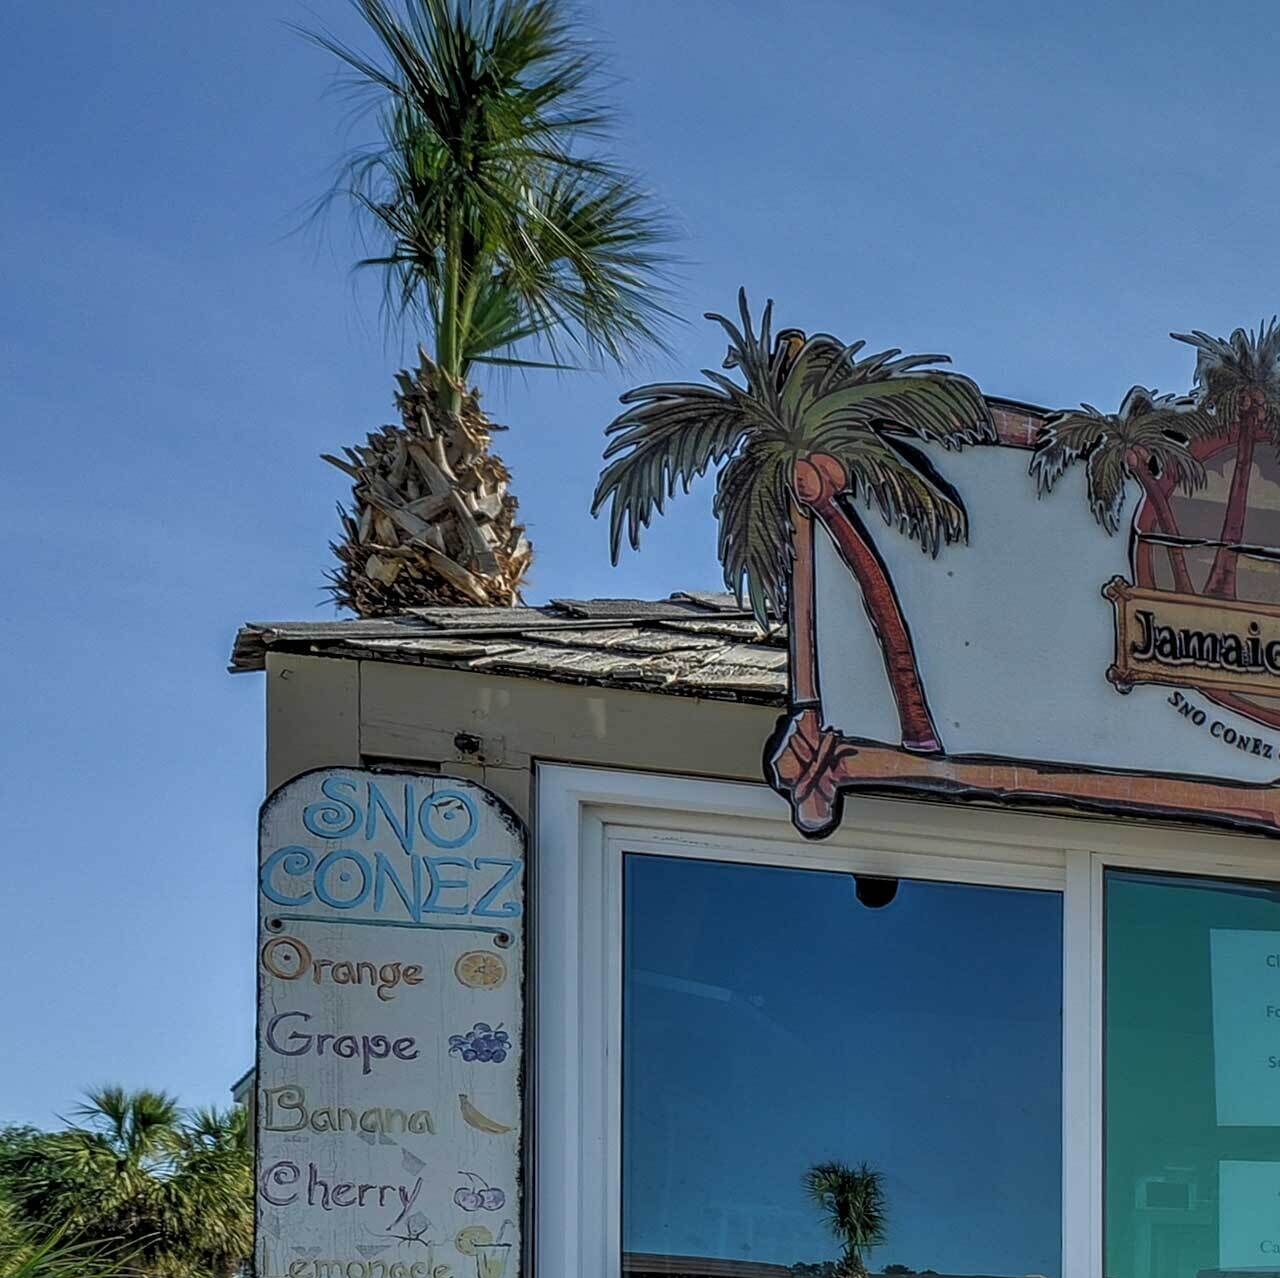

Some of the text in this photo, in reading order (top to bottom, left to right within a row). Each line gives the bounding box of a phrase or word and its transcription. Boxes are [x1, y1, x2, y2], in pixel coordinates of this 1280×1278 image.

[1167, 690, 1207, 727] SNO
[1209, 720, 1273, 760] CONEZ
[303, 777, 479, 850] SNO
[260, 845, 521, 922] CONEZ
[261, 934, 424, 1002] Orange
[264, 1011, 421, 1075] Grape
[263, 1085, 437, 1136] Banana
[260, 1160, 422, 1232] Cherry
